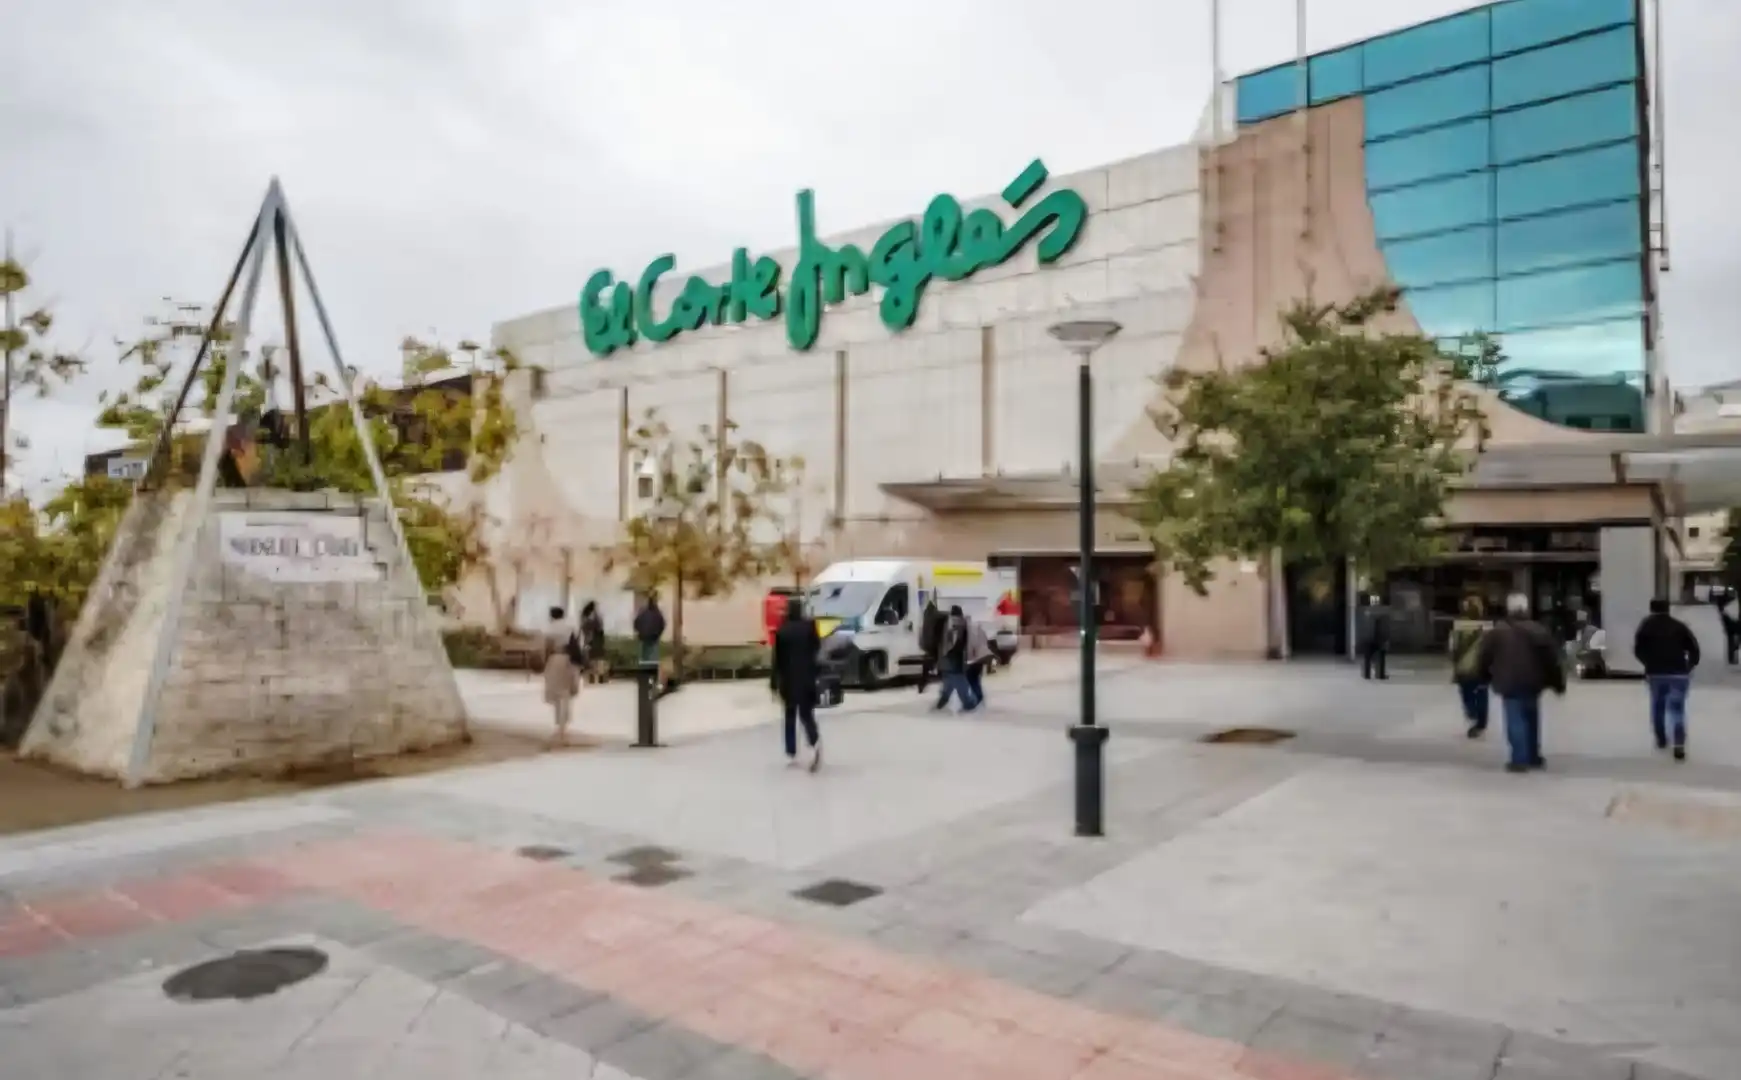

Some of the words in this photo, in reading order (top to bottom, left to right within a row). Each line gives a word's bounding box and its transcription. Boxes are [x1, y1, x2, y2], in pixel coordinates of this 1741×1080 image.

[581, 268, 637, 356] El
[636, 247, 781, 342] Corte
[786, 159, 1088, 351] Inglés
